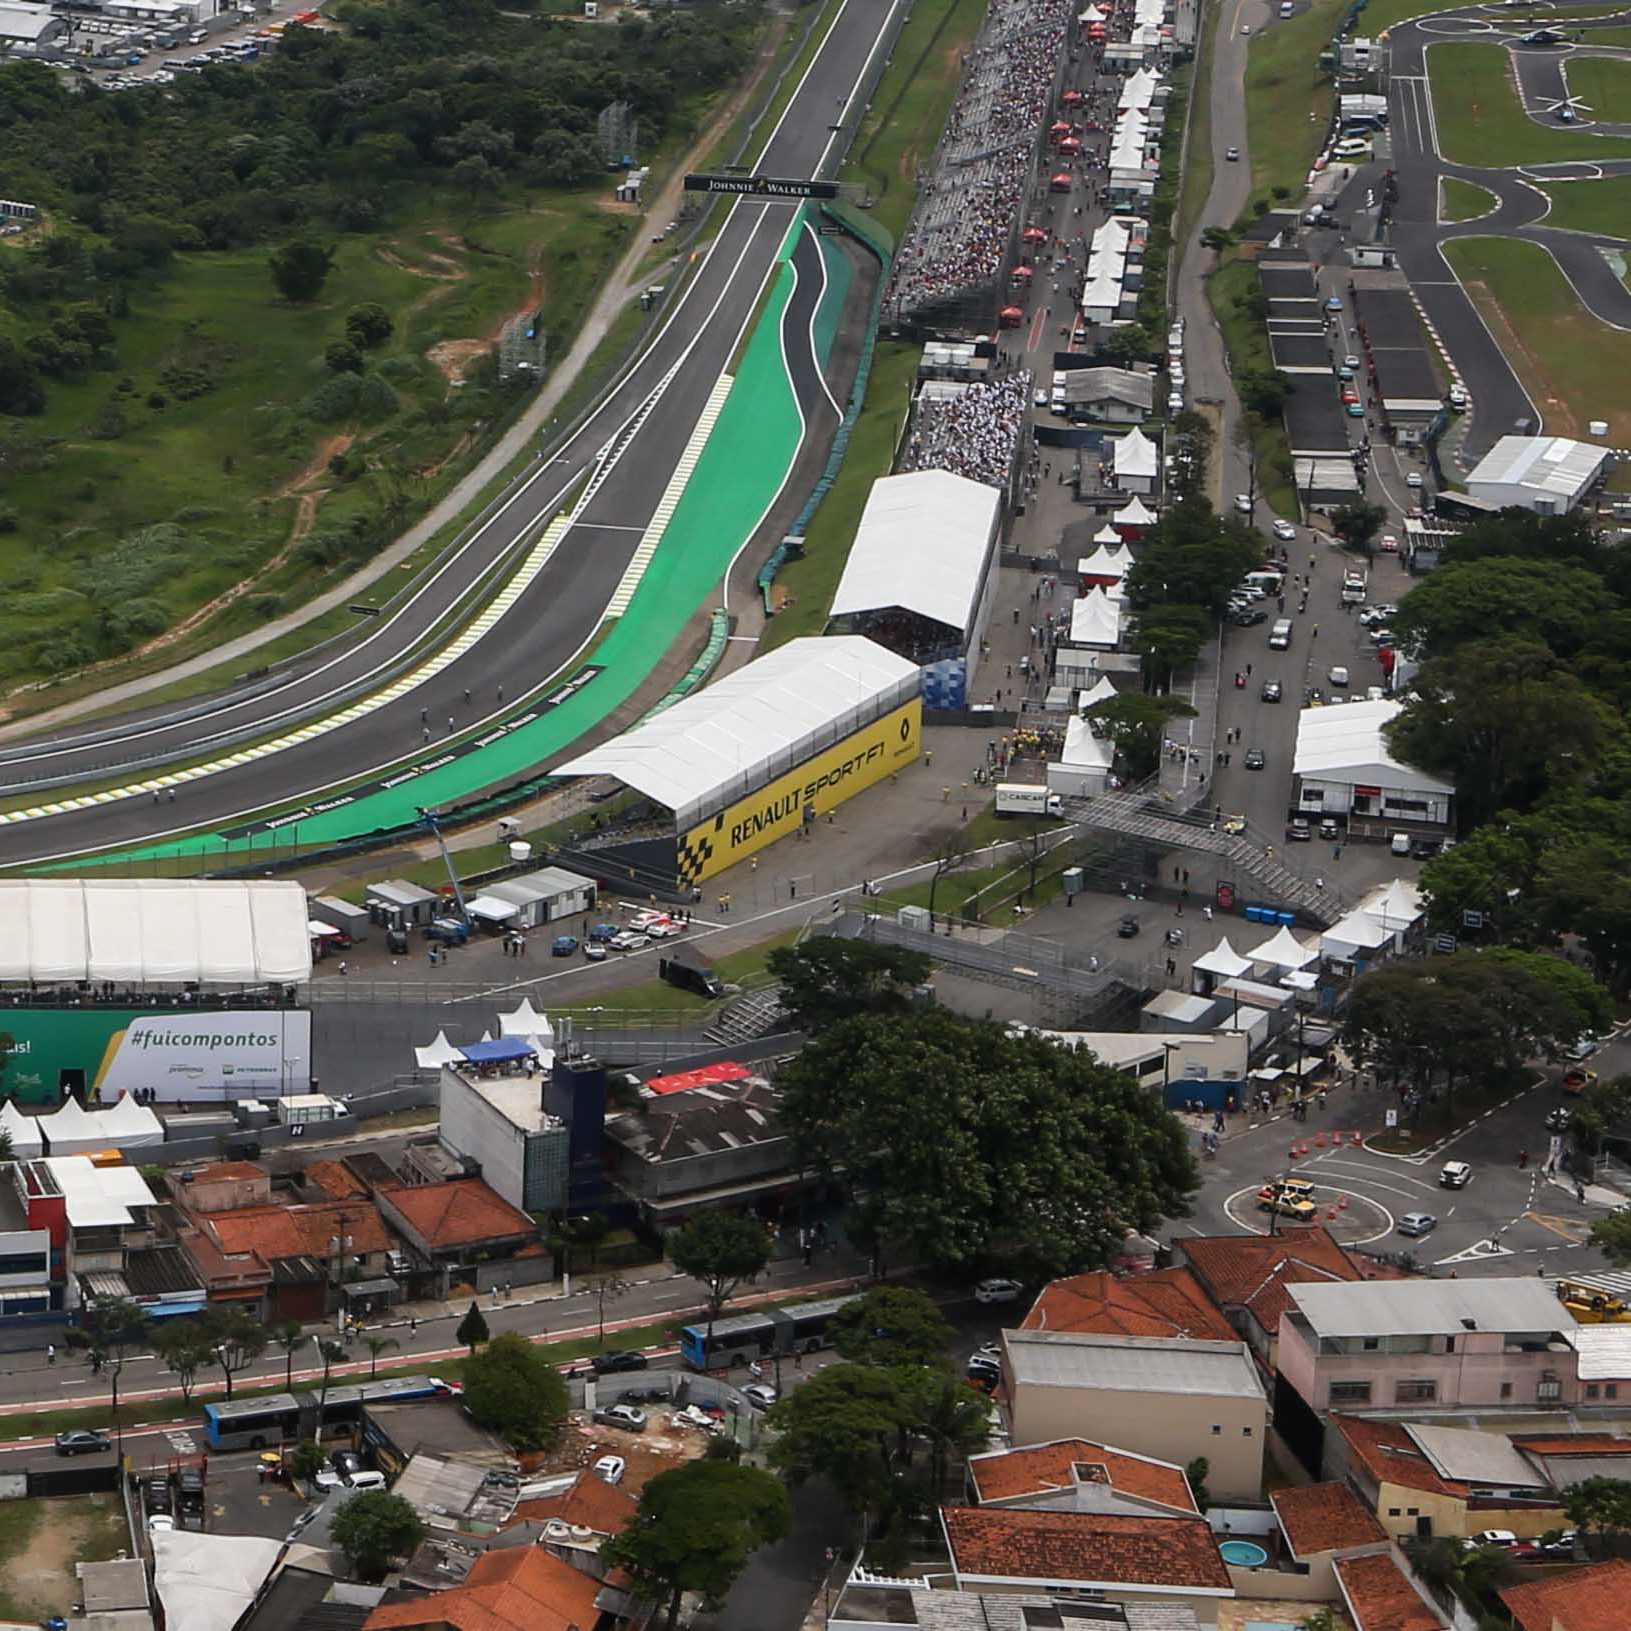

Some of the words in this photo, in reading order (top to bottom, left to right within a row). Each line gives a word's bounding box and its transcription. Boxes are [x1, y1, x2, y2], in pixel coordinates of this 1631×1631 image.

[708, 180, 754, 192] JOHNNIE
[767, 183, 811, 195] WALKER
[730, 788, 803, 848] RENAULT
[803, 753, 865, 801] SPORT
[865, 742, 886, 765] F1
[131, 1029, 278, 1049] #fuicompontos
[292, 1126, 302, 1135] H
